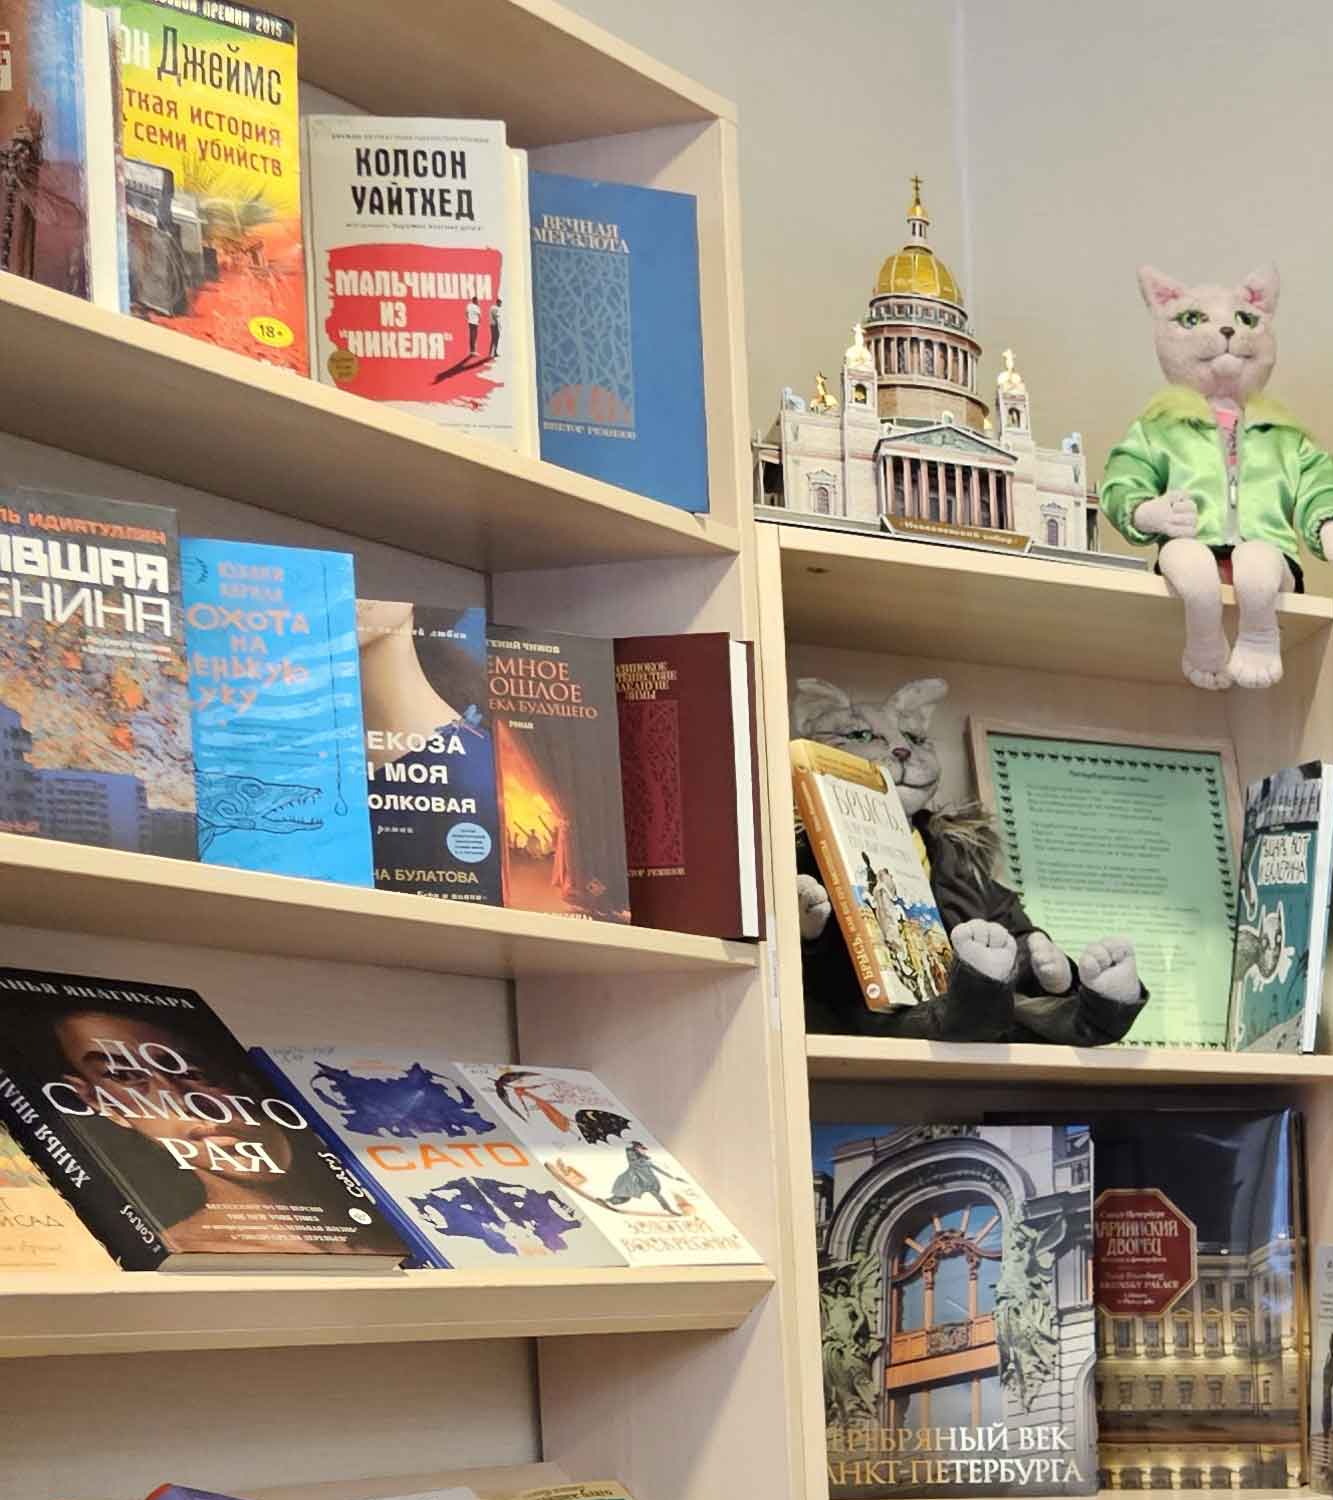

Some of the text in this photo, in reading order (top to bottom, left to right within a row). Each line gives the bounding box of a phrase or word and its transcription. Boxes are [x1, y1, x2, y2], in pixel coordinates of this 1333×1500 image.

[256, 17, 283, 38] 2015
[157, 25, 281, 105] Джеймс
[127, 86, 281, 147] ткая история
[134, 120, 283, 177] семи убийств
[355, 146, 467, 180] КОЛСОН
[352, 181, 475, 220] УАЙТХЕД
[541, 214, 620, 237] ВЕЧНАЯ
[335, 270, 493, 300] МАЛЬЧИШКИ
[379, 301, 408, 328] ИЗ
[258, 323, 283, 338] 18+
[187, 602, 310, 636] ОХОТА
[519, 700, 599, 719] БУДУЩЕГО
[368, 731, 466, 755] ЕКОЗА
[385, 761, 448, 784] МОЯ
[395, 867, 479, 884] БУЛАТОВА
[66, 982, 195, 1011] ЯНАГИХАРА
[88, 1036, 191, 1076] ДО
[40, 1078, 309, 1134] САМОГО
[158, 1134, 287, 1175] РАЯ
[364, 1142, 531, 1172] САТО
[1106, 1237, 1162, 1257] ДВОРЕЦ
[828, 1421, 1071, 1451] ЕРЕБРЯНЫЙ ВЕК
[826, 1456, 1084, 1485] АНКТ-ПЕТЕРБУРГА
